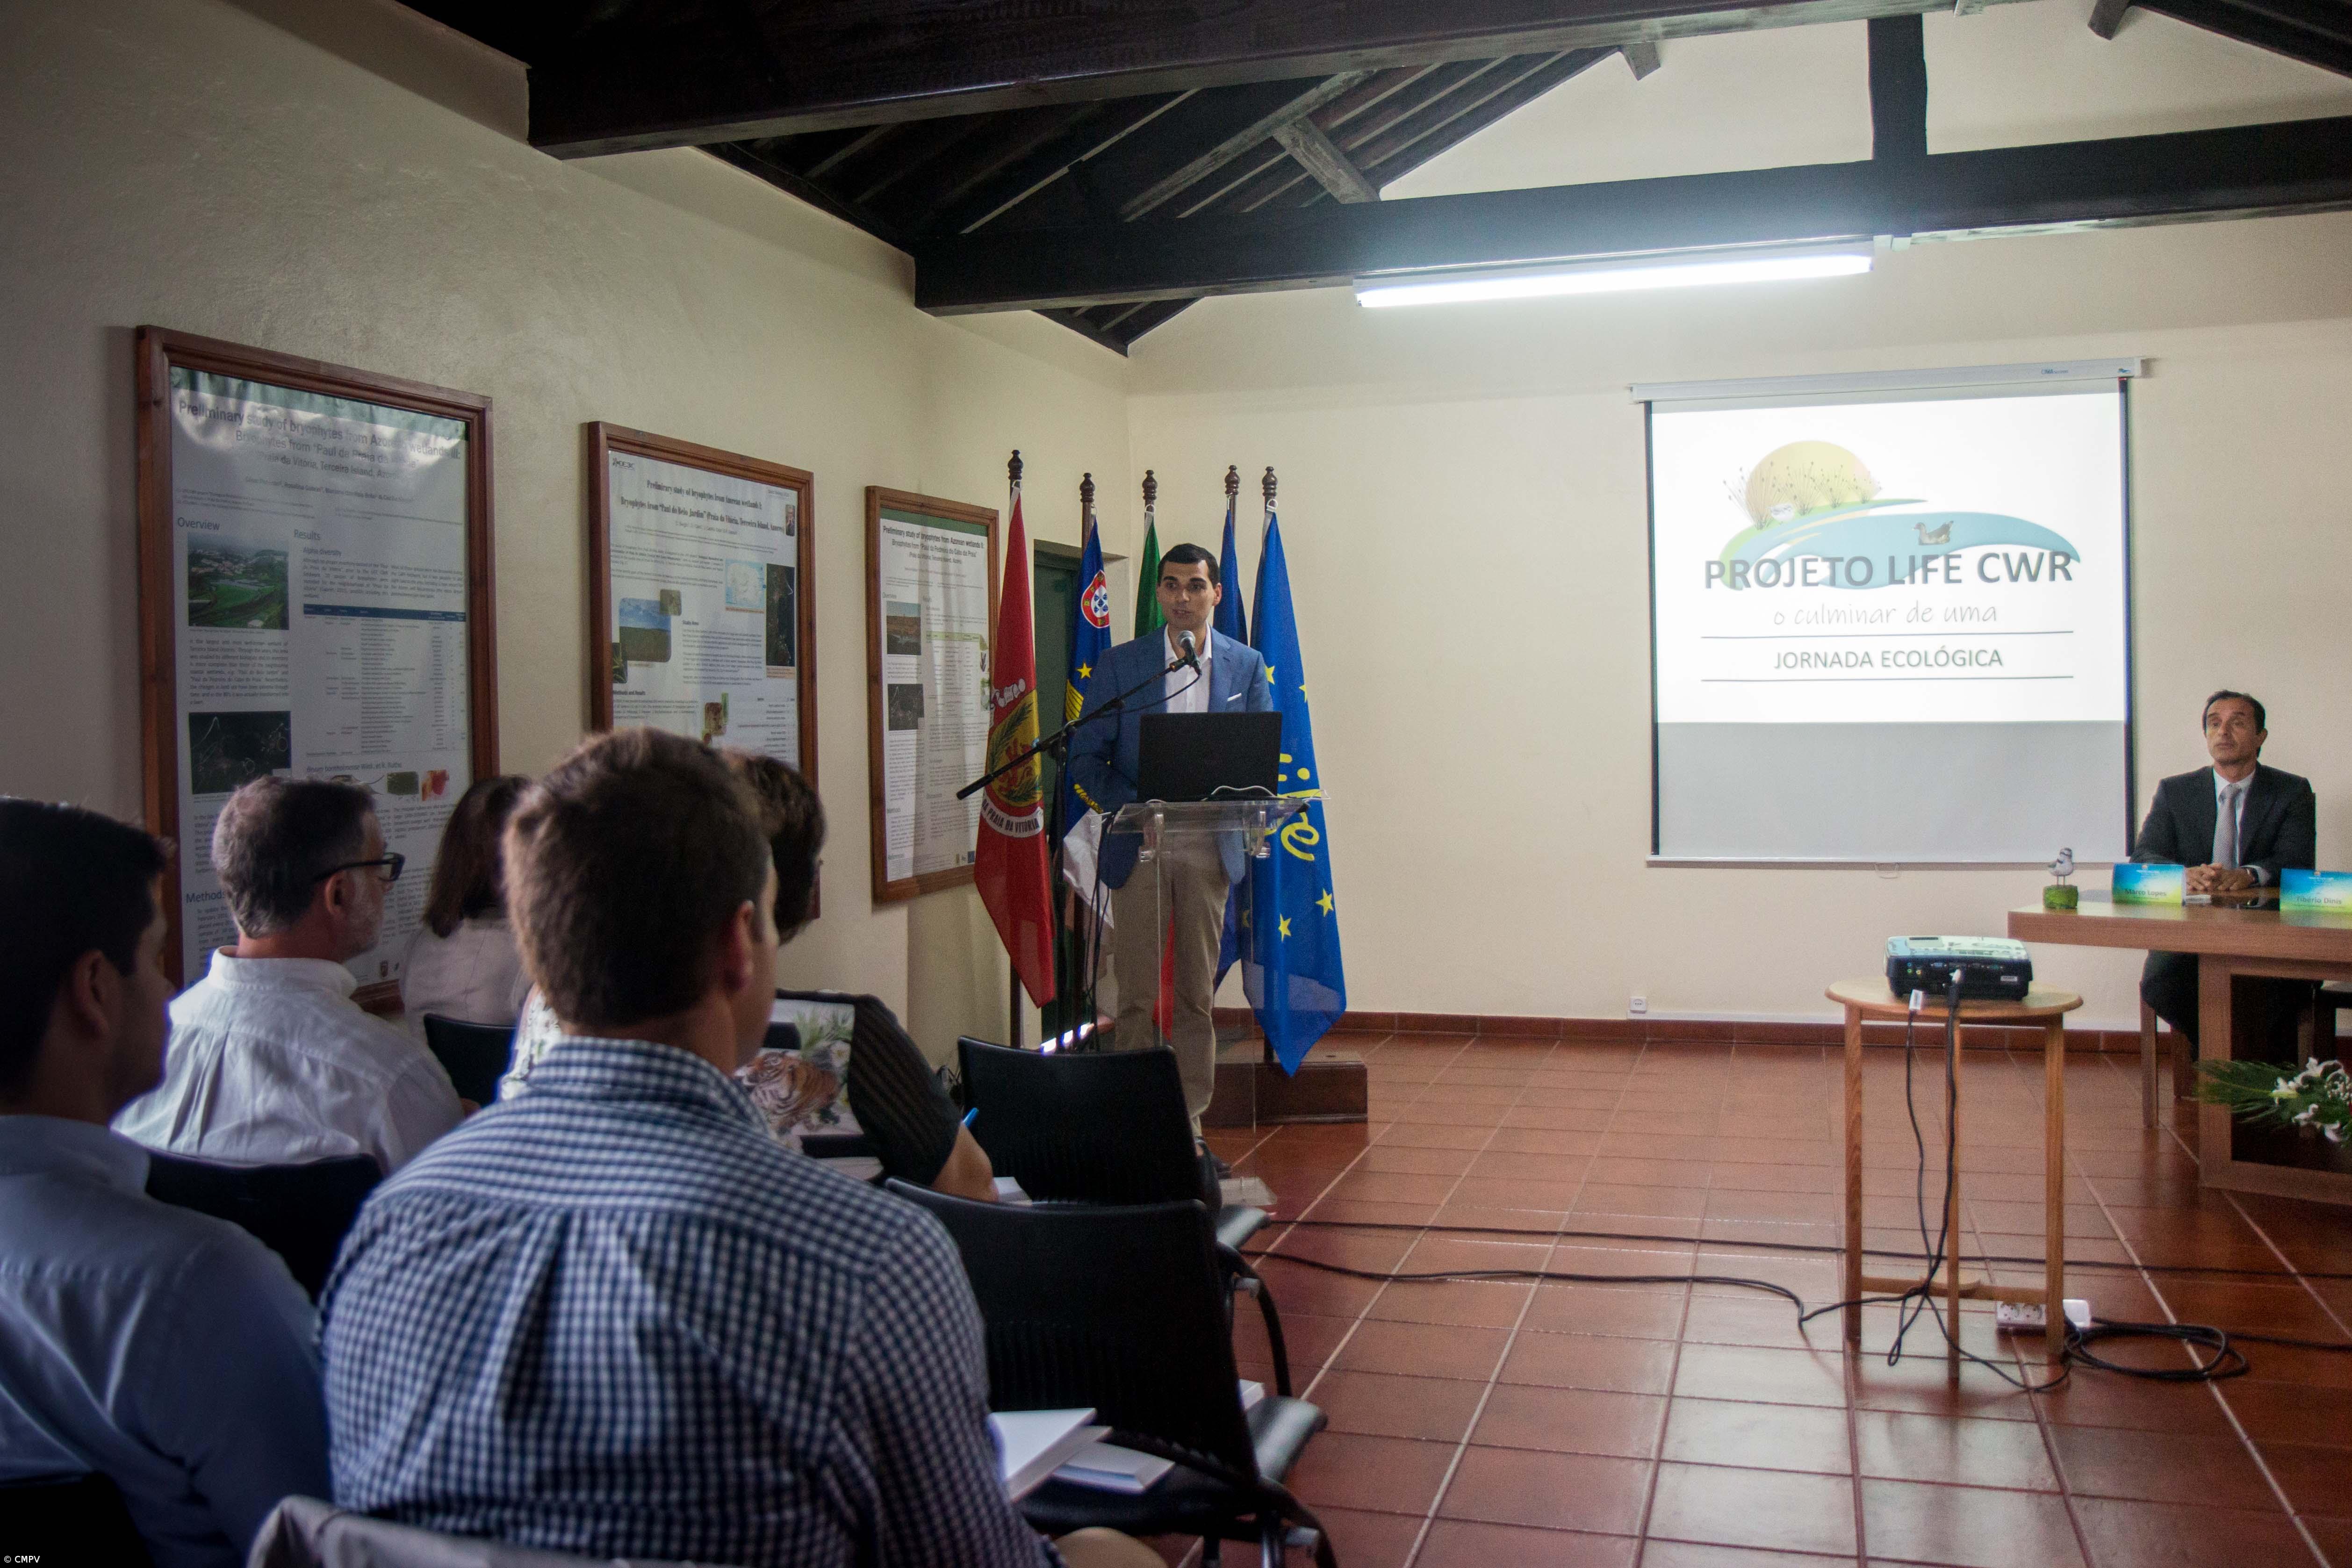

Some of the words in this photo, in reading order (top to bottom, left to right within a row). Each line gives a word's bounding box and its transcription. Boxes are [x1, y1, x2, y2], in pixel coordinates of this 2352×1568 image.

[180, 400, 244, 425] Preliminary
[248, 413, 273, 431] study
[277, 419, 287, 431] of
[290, 420, 343, 440] bryophytes
[346, 431, 367, 444] from
[370, 434, 407, 450] Azor
[289, 439, 310, 452] from
[338, 448, 350, 458] da
[281, 454, 291, 465] da
[321, 460, 349, 474] Terceira
[647, 479, 672, 495] Preliminary
[673, 486, 684, 497] study
[714, 493, 725, 502] from
[621, 496, 647, 510] Bryophytes
[647, 501, 659, 511] from
[177, 517, 220, 531] Overview
[294, 529, 321, 541] Results
[1705, 556, 1873, 589] PROJETO
[1888, 553, 1963, 585] LIFE
[1977, 550, 2073, 583] CWR
[1774, 612, 1785, 625] o
[1794, 603, 1896, 625] culminar
[1906, 600, 1933, 624] de
[1943, 605, 1997, 622] uma
[1775, 651, 1873, 670] JORNADA
[1881, 645, 2004, 667] ECOLÓGICA
[987, 807, 1005, 828] PRAIA
[1005, 820, 1014, 831] DA
